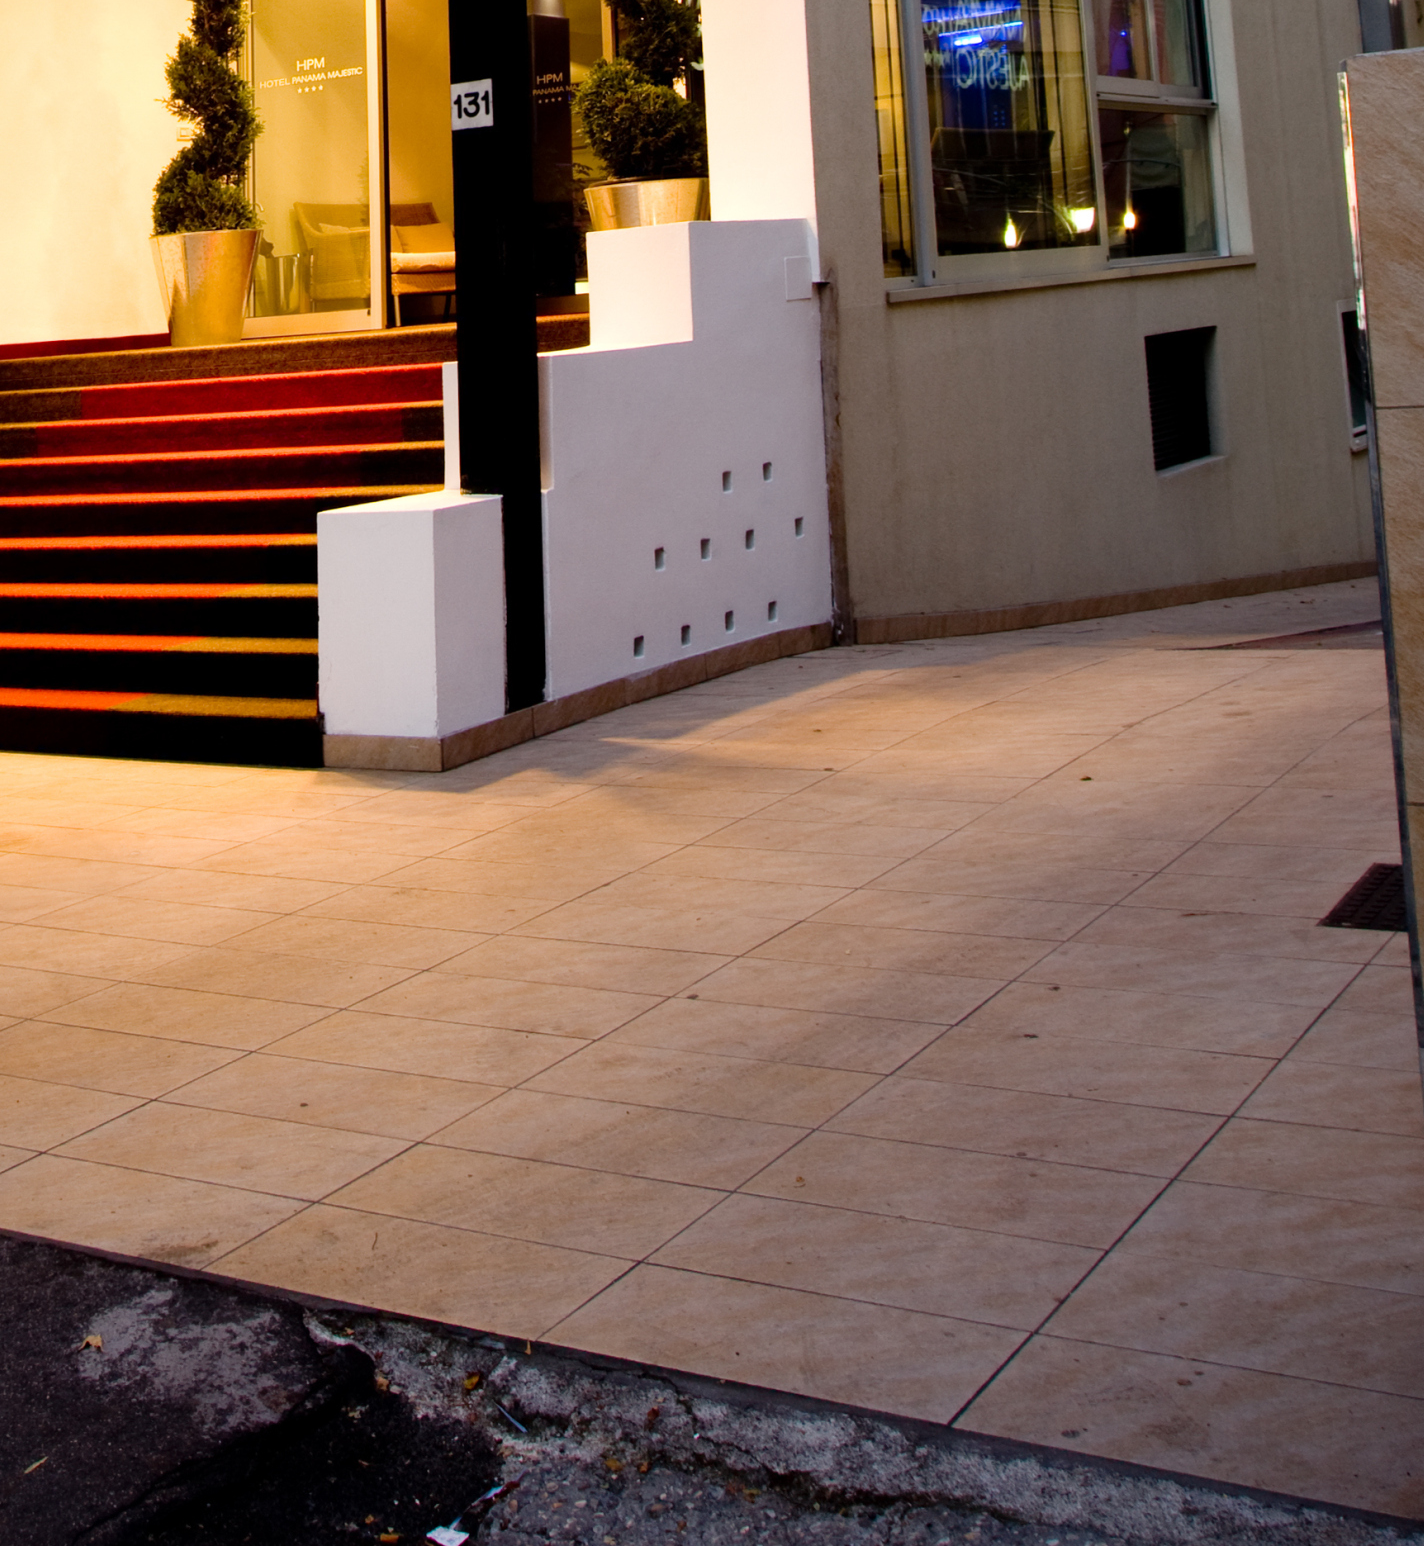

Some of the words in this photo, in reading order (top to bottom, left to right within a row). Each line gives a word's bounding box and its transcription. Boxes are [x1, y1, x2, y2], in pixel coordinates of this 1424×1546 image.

[296, 56, 325, 71] HPM
[259, 77, 290, 89] HOTEL
[291, 72, 325, 84] PANAMA
[327, 67, 362, 79] MAJESTIC
[536, 72, 563, 84] HPM
[453, 89, 491, 120] 131
